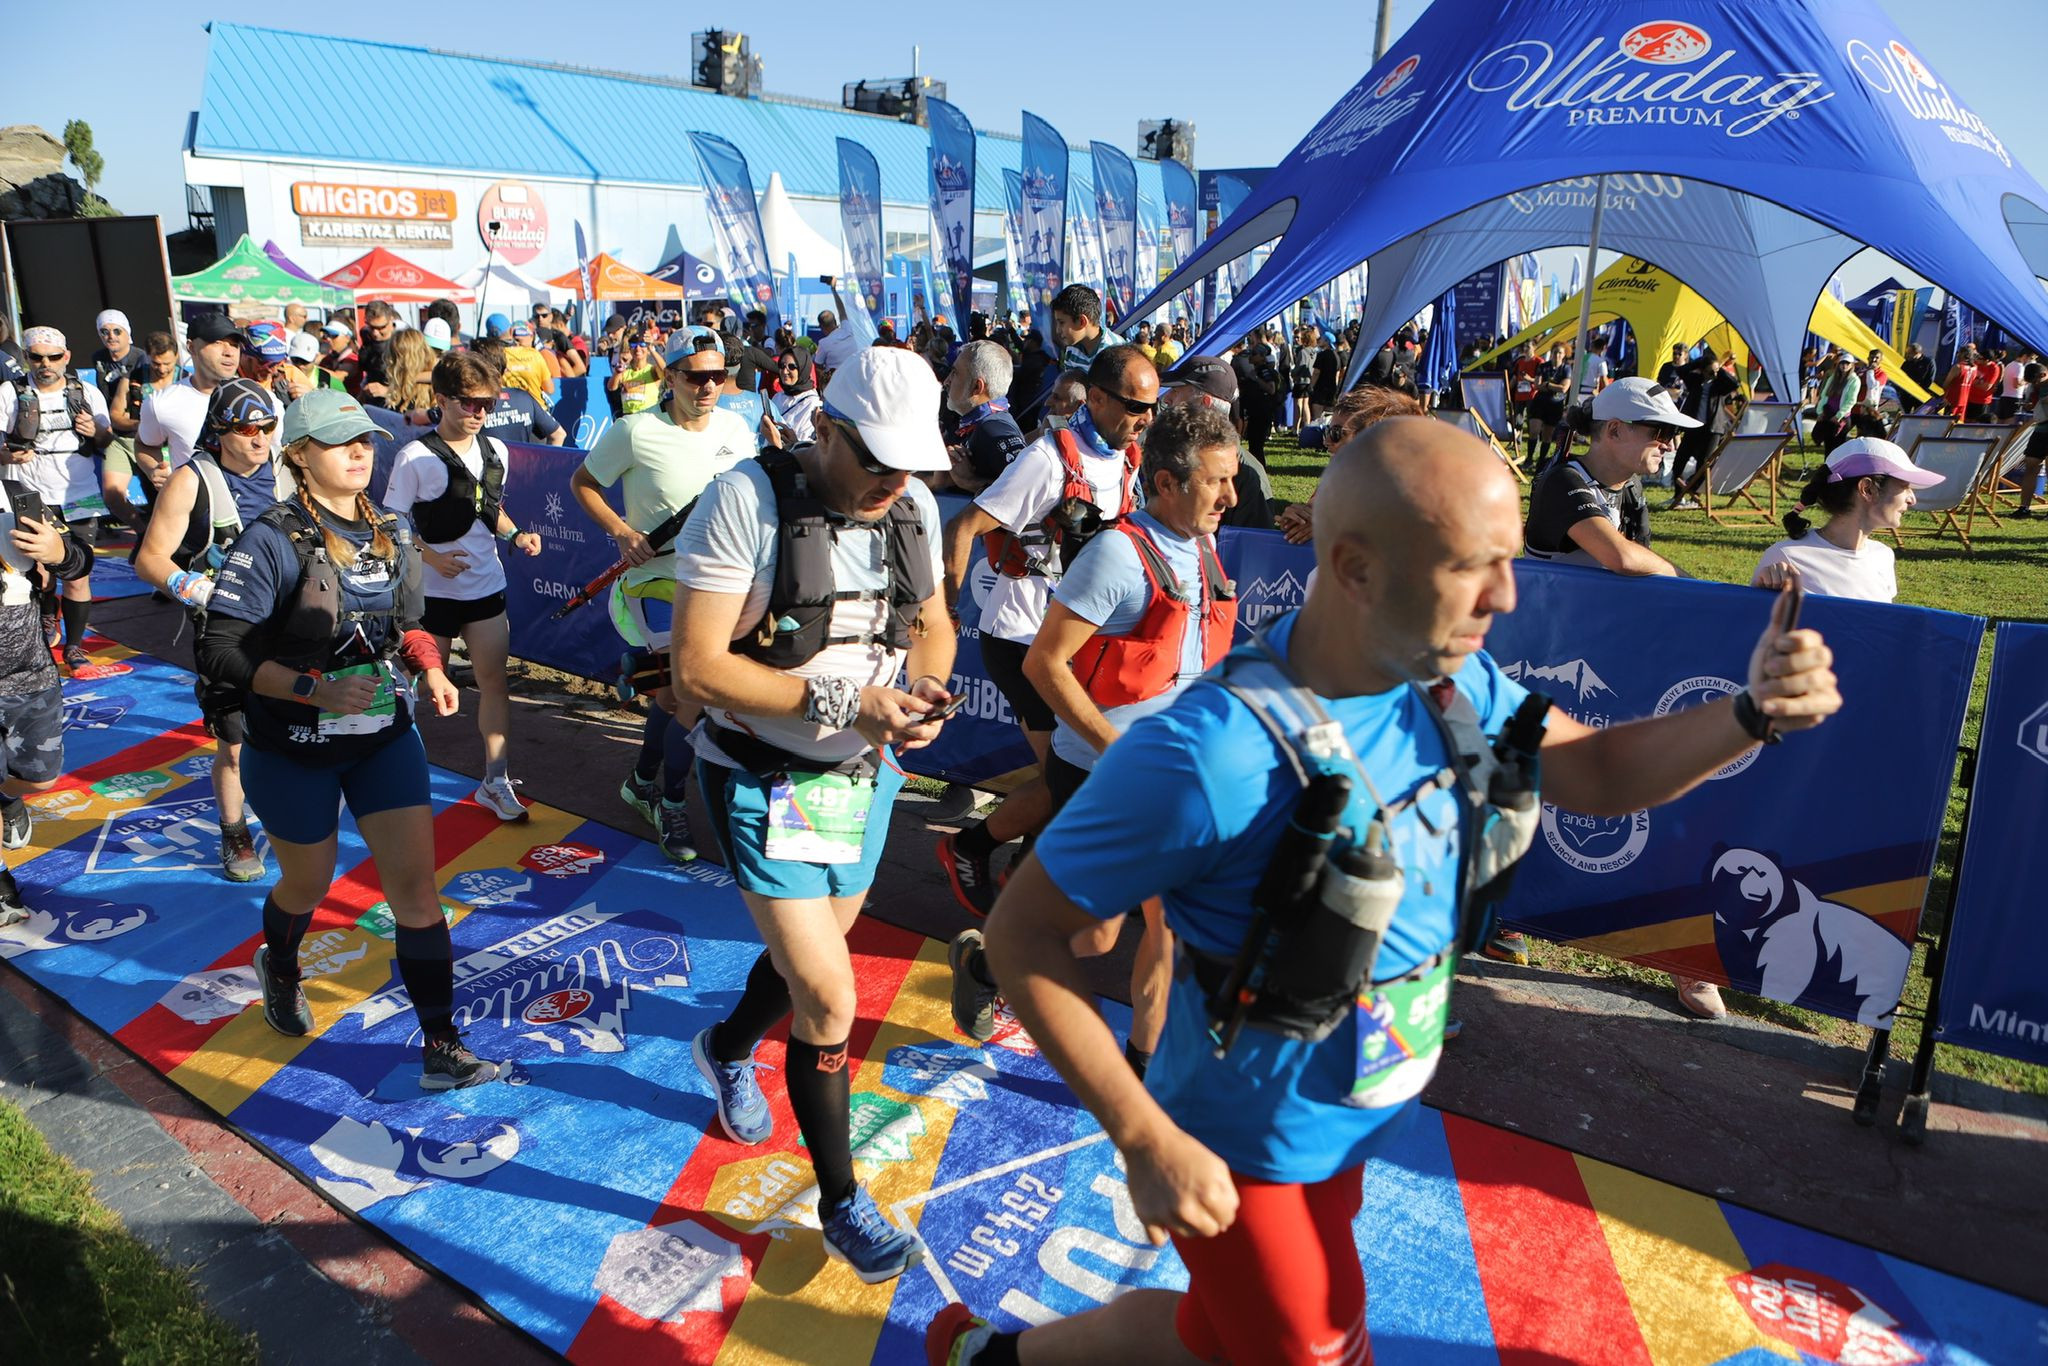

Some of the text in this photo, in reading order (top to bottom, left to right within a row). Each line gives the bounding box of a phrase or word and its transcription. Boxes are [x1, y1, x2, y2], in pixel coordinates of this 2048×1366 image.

[1467, 37, 1836, 138] Uludağ
[1566, 105, 1724, 128] PREMIUM
[298, 184, 448, 217] MiGROS jet
[307, 221, 451, 241] KARBEYAZ RENTAL
[559, 525, 586, 543] HOTEL
[533, 578, 593, 608] GARM
[1245, 604, 1303, 626] UP
[1656, 687, 1681, 717] TÜRKİYE
[1681, 675, 1721, 690] ATLETİZM
[114, 801, 214, 837] 2543 m
[1546, 830, 1637, 872] SEARCH AND RESCUE
[486, 913, 596, 960] ULTRA
[463, 947, 563, 994] PREMIUM
[405, 938, 679, 1049] Uluda
[723, 1159, 801, 1217] UP16
[946, 1172, 1064, 1279] 2543 m
[1749, 1274, 1785, 1320] 100
[1783, 1277, 1823, 1342] UPUT
